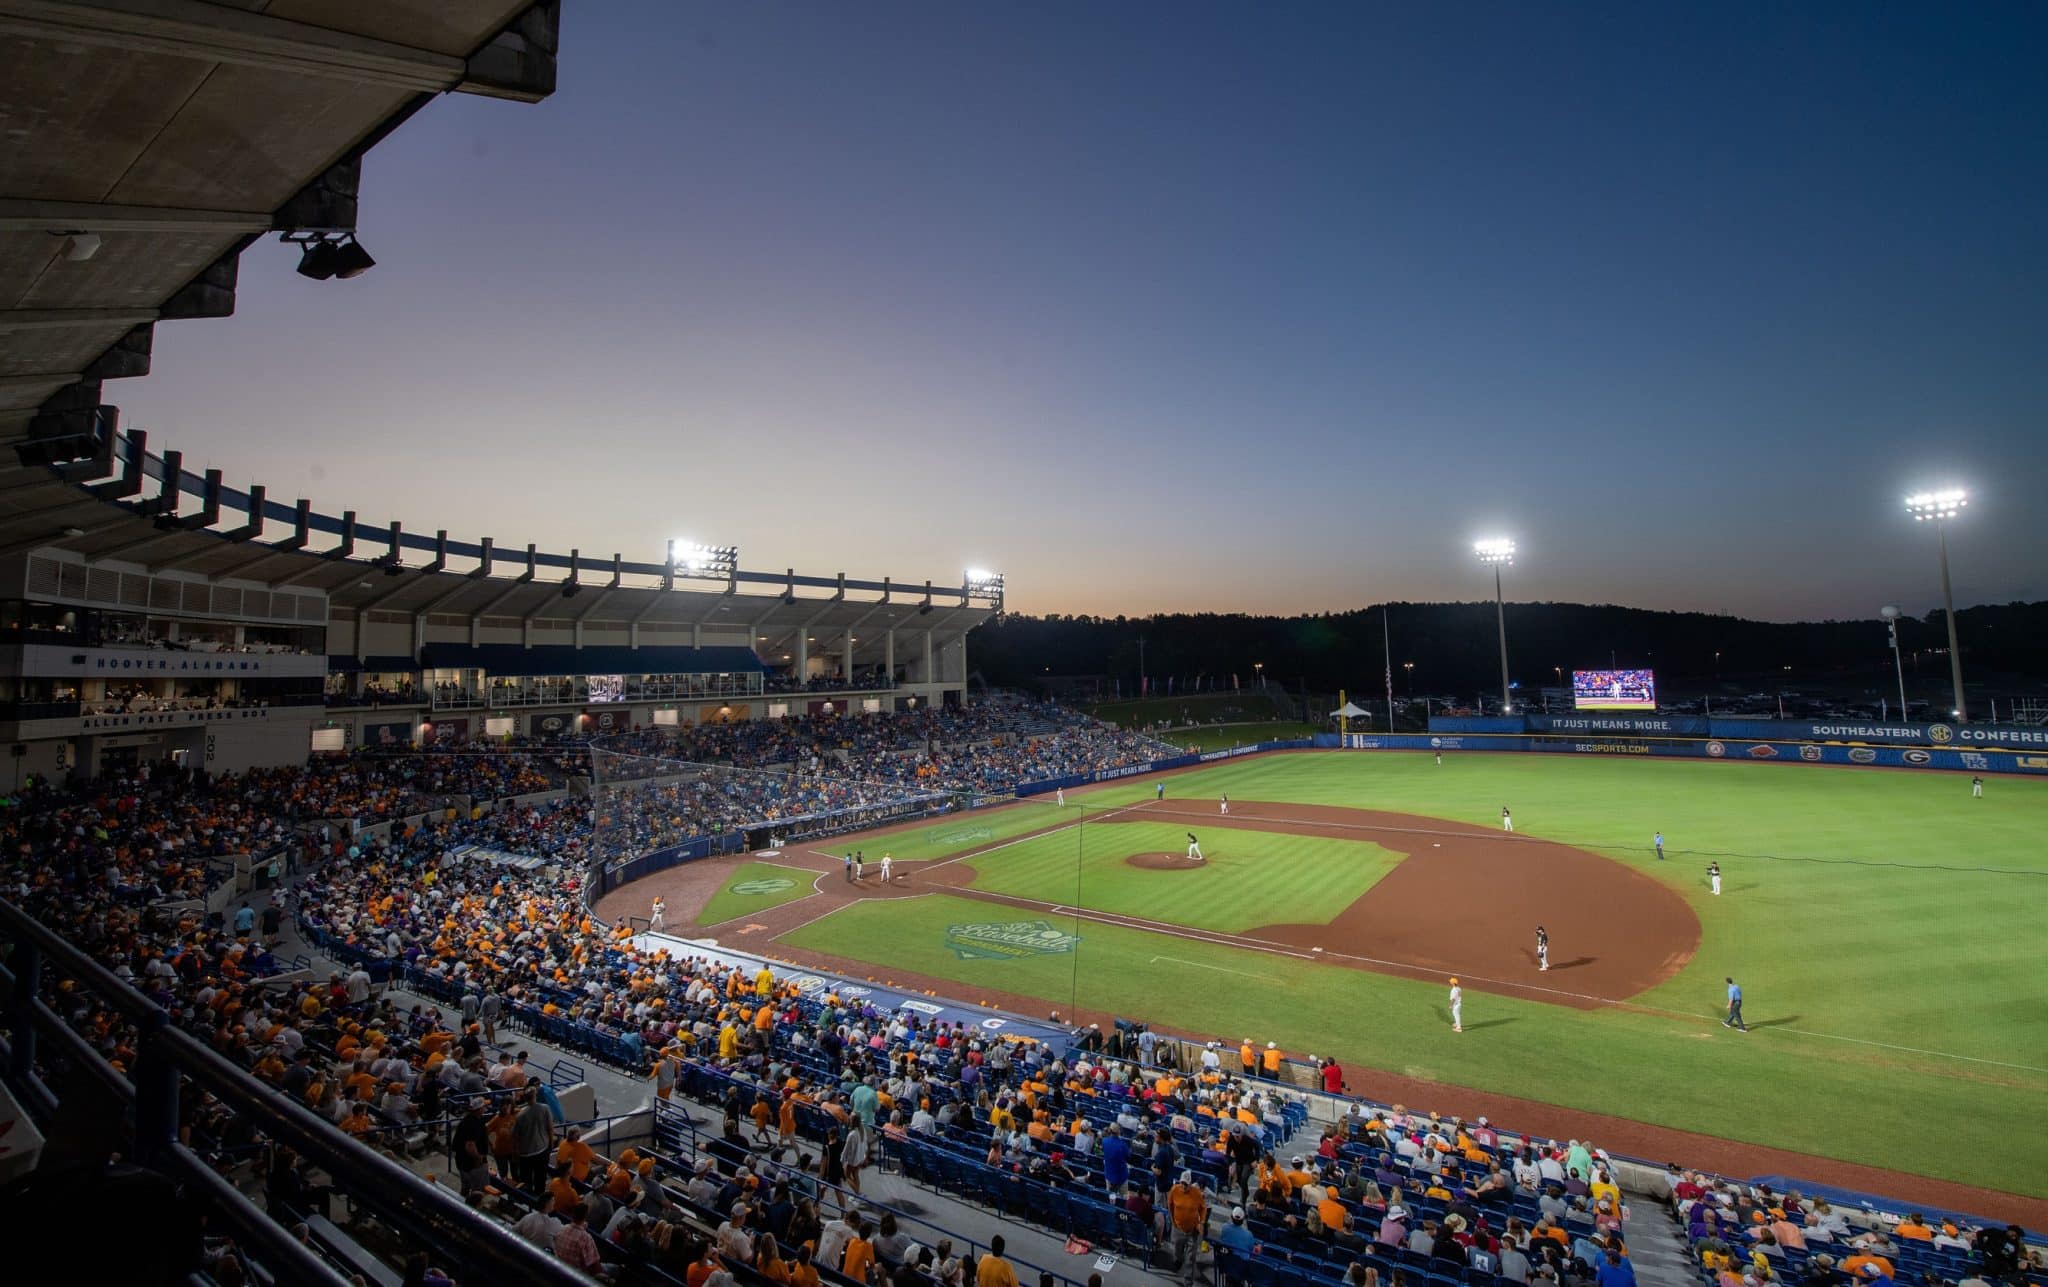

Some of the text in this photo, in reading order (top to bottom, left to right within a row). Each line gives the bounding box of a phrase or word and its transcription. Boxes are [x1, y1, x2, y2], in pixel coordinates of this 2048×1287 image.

[181, 661, 260, 671] ALABAMA
[83, 708, 267, 728] ALLEN PATE PRESS BOX
[1552, 719, 1672, 731] IT JUST MEANS MORE.
[1812, 725, 1921, 738] SOUTHEASTERN
[1575, 743, 1649, 754] SECSPORTS.COM
